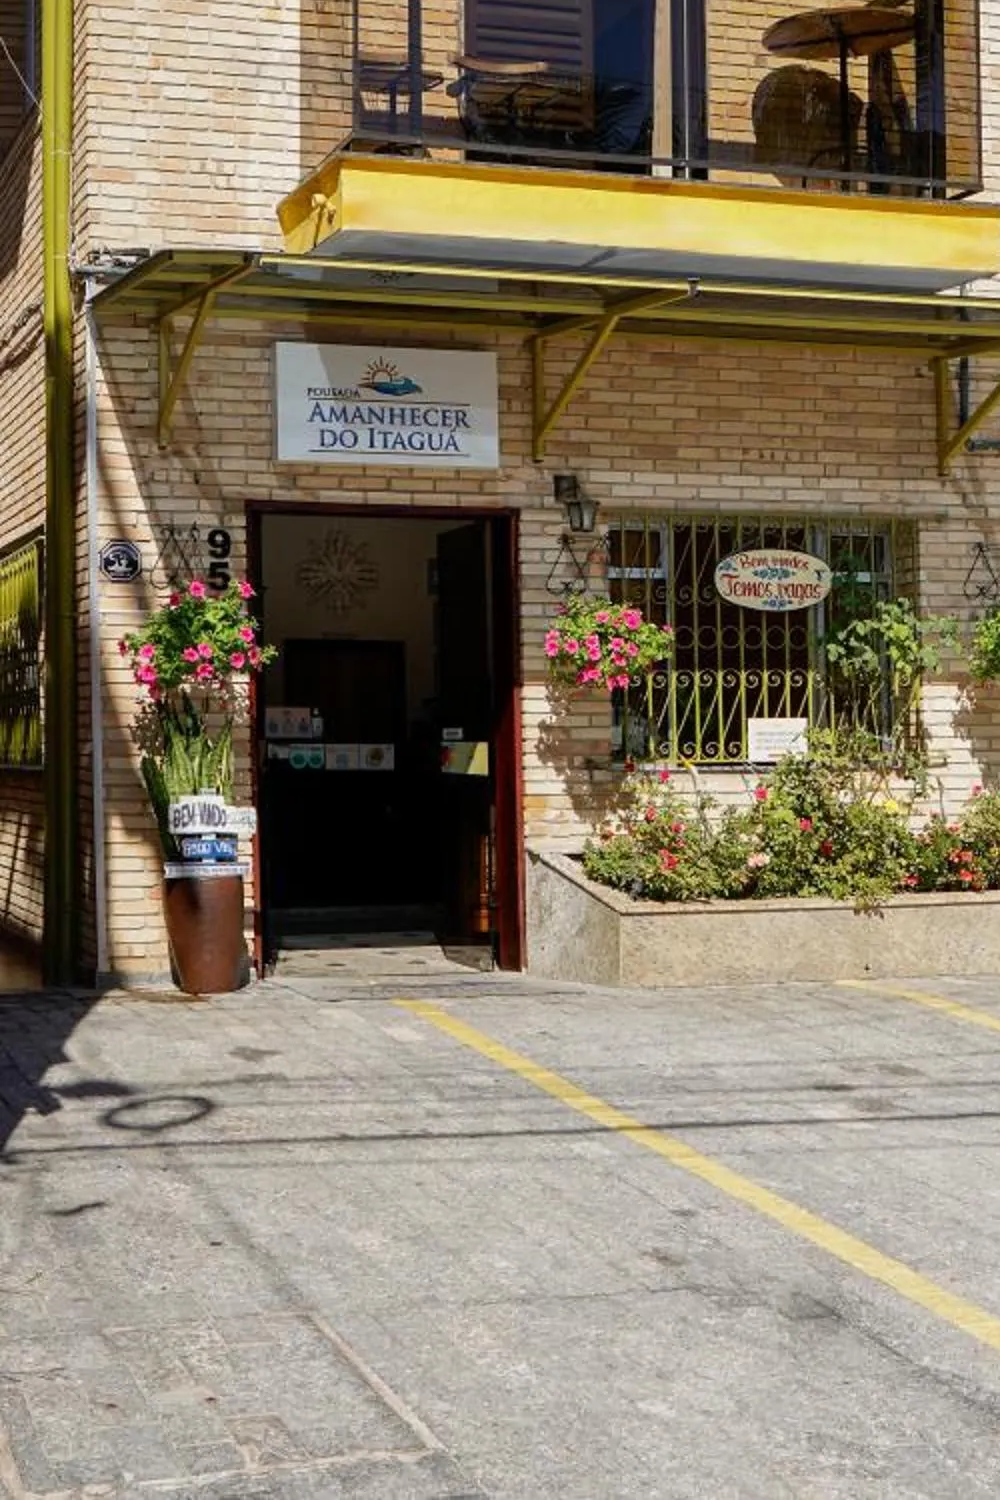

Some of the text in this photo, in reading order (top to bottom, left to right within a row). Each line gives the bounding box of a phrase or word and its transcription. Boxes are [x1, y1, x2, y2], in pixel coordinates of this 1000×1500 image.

[307, 387, 360, 399] POUSADA
[307, 402, 470, 428] AMANHECER
[319, 425, 461, 452] DO ITAGUÁ
